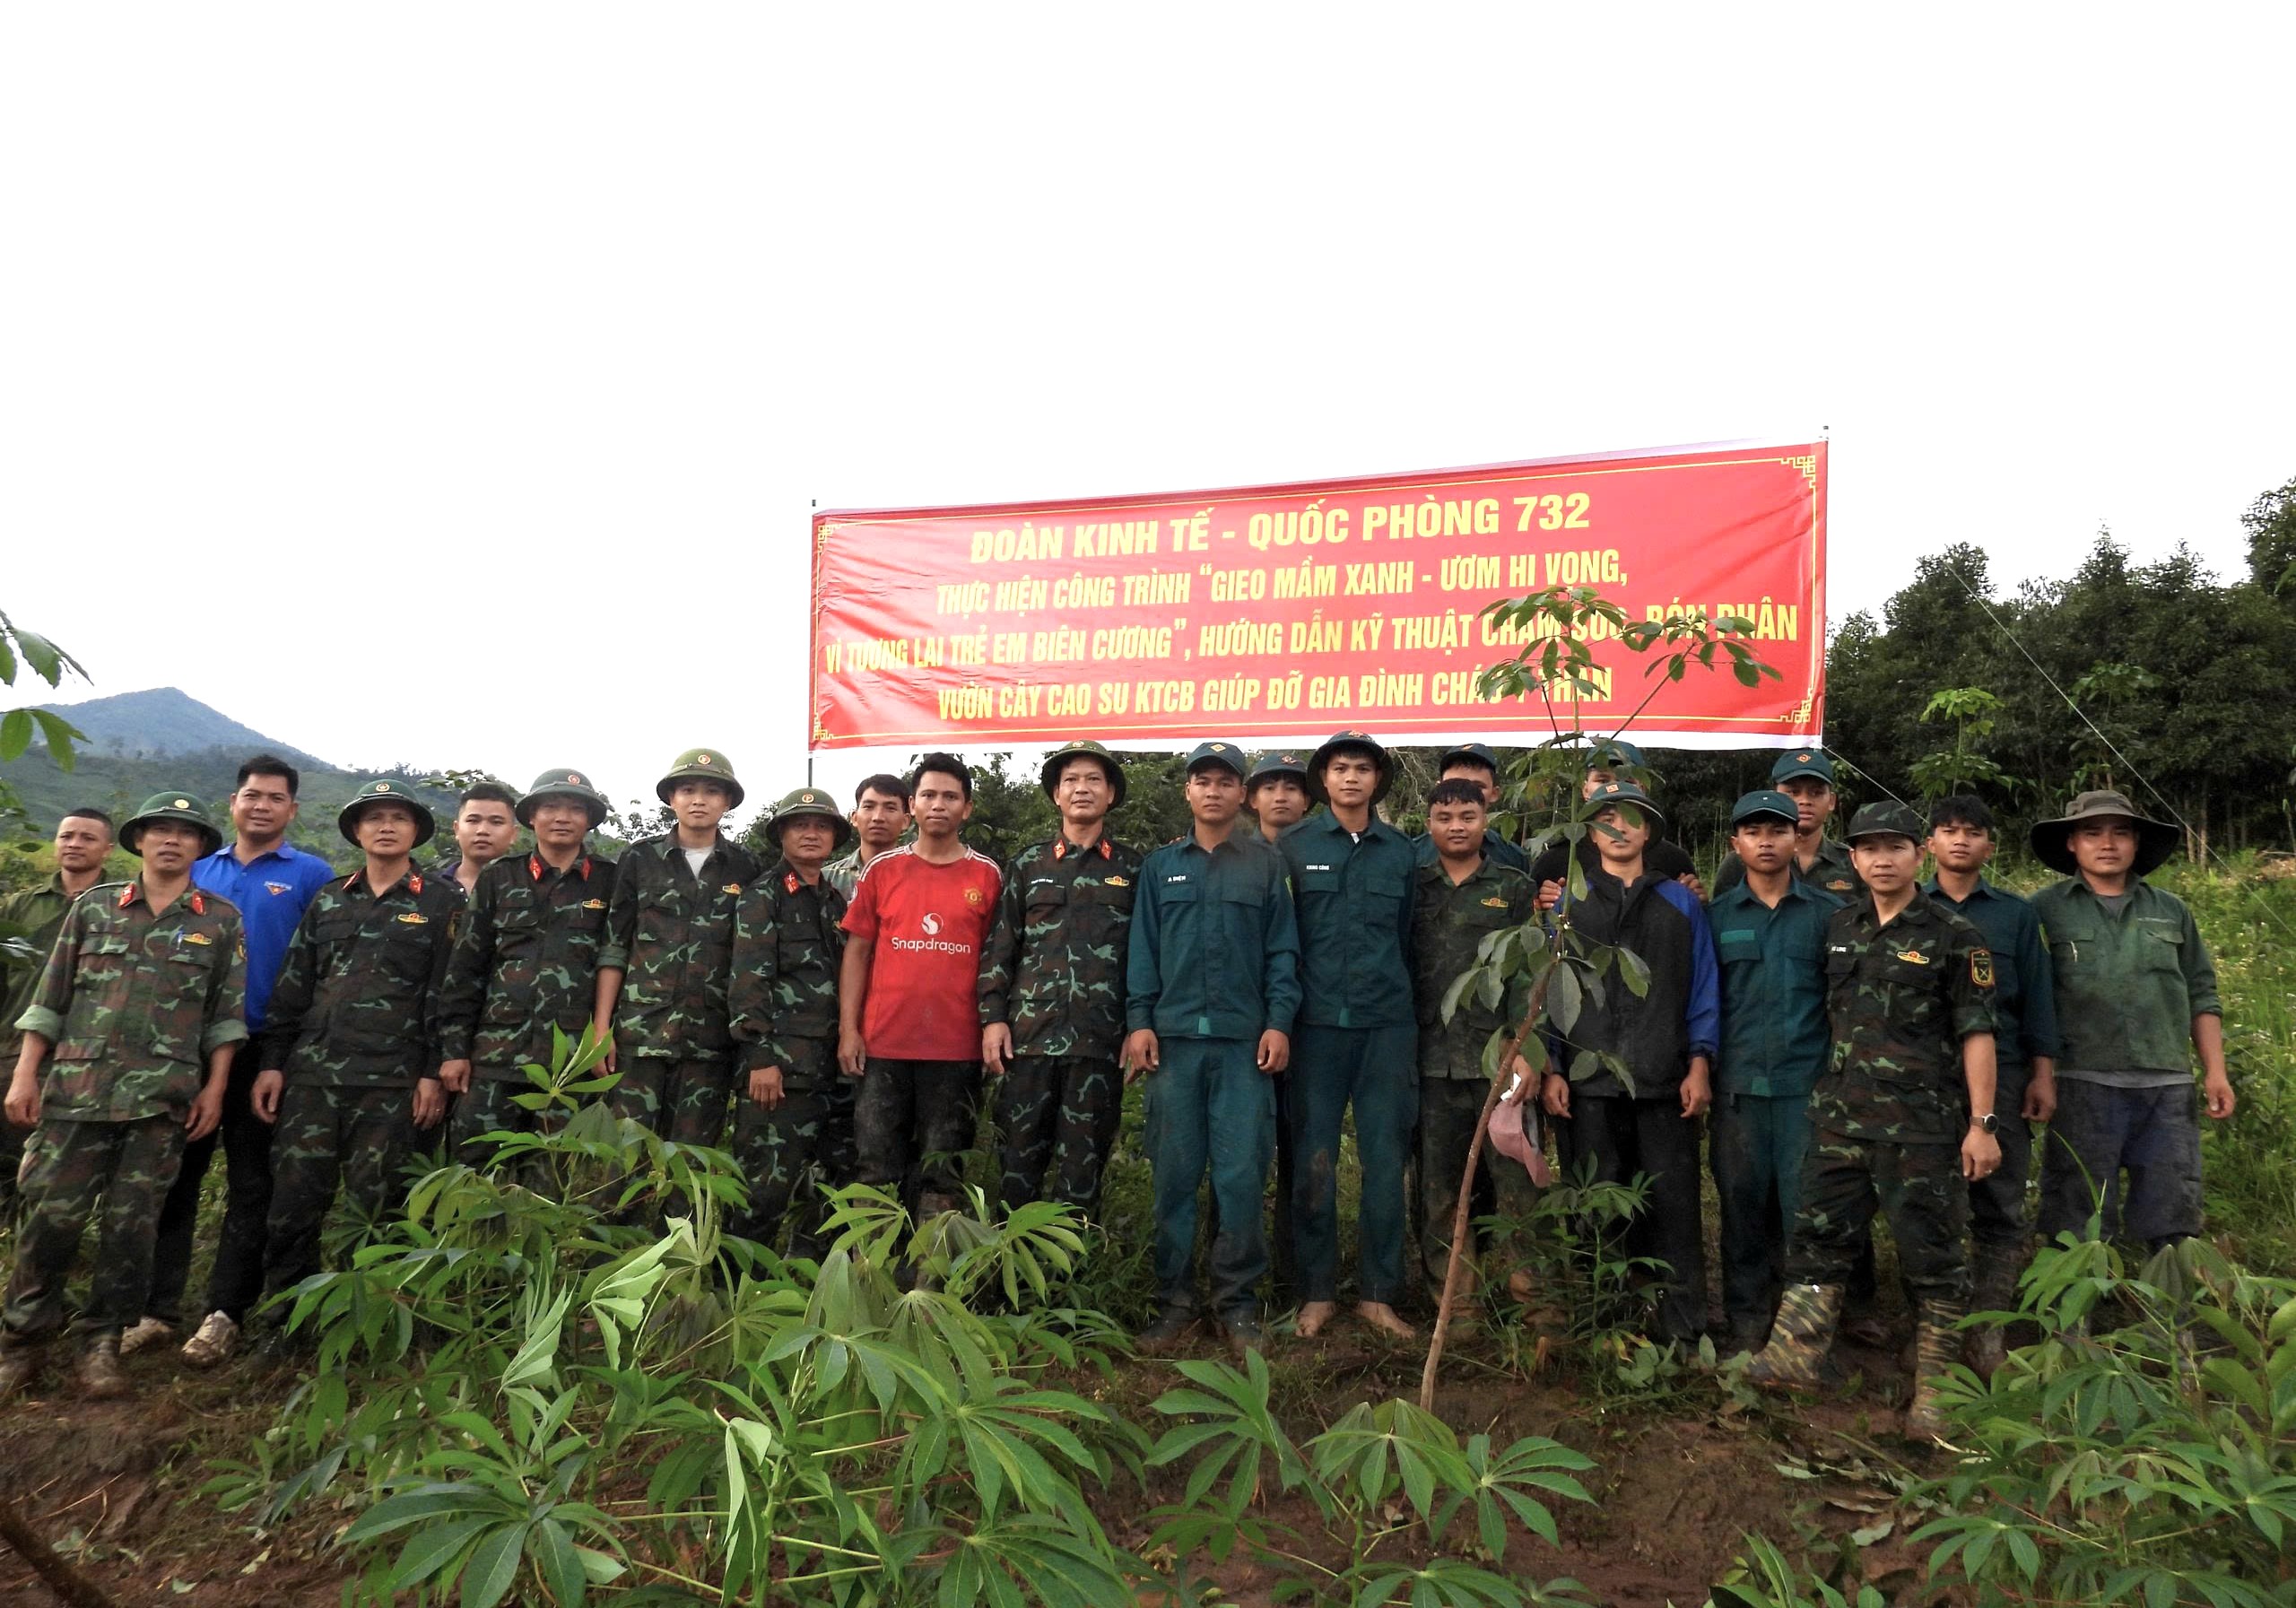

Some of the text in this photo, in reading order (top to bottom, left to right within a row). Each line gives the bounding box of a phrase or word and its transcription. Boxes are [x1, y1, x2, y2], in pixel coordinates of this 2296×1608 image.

[970, 522, 1065, 564] ĐOÀN
[1073, 521, 1158, 558] KINH
[1170, 508, 1213, 552] TẾ
[1248, 498, 1349, 551] QUỐC
[1363, 495, 1499, 540] PHÒNG
[1514, 493, 1589, 531] 732
[936, 580, 991, 618] THỰC
[994, 575, 1048, 616] HIỆN
[1052, 571, 1116, 609] CÔNG
[1122, 568, 1191, 605] TRÌNH
[1274, 556, 1336, 599] MẦM
[1344, 561, 1413, 595] XANH
[1441, 554, 1500, 590] ƯƠM
[1509, 555, 1535, 587] HI
[1545, 550, 1627, 593] VỌNG,
[914, 636, 944, 668] LAI
[949, 625, 987, 666] TRẺ
[992, 631, 1028, 664] EM
[1031, 625, 1086, 662] BIÊN
[1199, 618, 1283, 656] HƯỚNG
[1291, 610, 1342, 653] DẪN
[1351, 613, 1383, 650] KỸ
[1392, 609, 1474, 655] THUẬT
[999, 679, 1043, 717] CÂY
[1048, 683, 1091, 716] CAO
[1098, 682, 1129, 714] SU
[1135, 681, 1195, 713] KTCB
[1203, 673, 1260, 711] GIÚP
[1267, 670, 1303, 709] ĐỠ
[1309, 676, 1350, 708] GIA
[1360, 668, 1422, 707] ĐÌNH
[891, 937, 970, 954] Snapdragon
